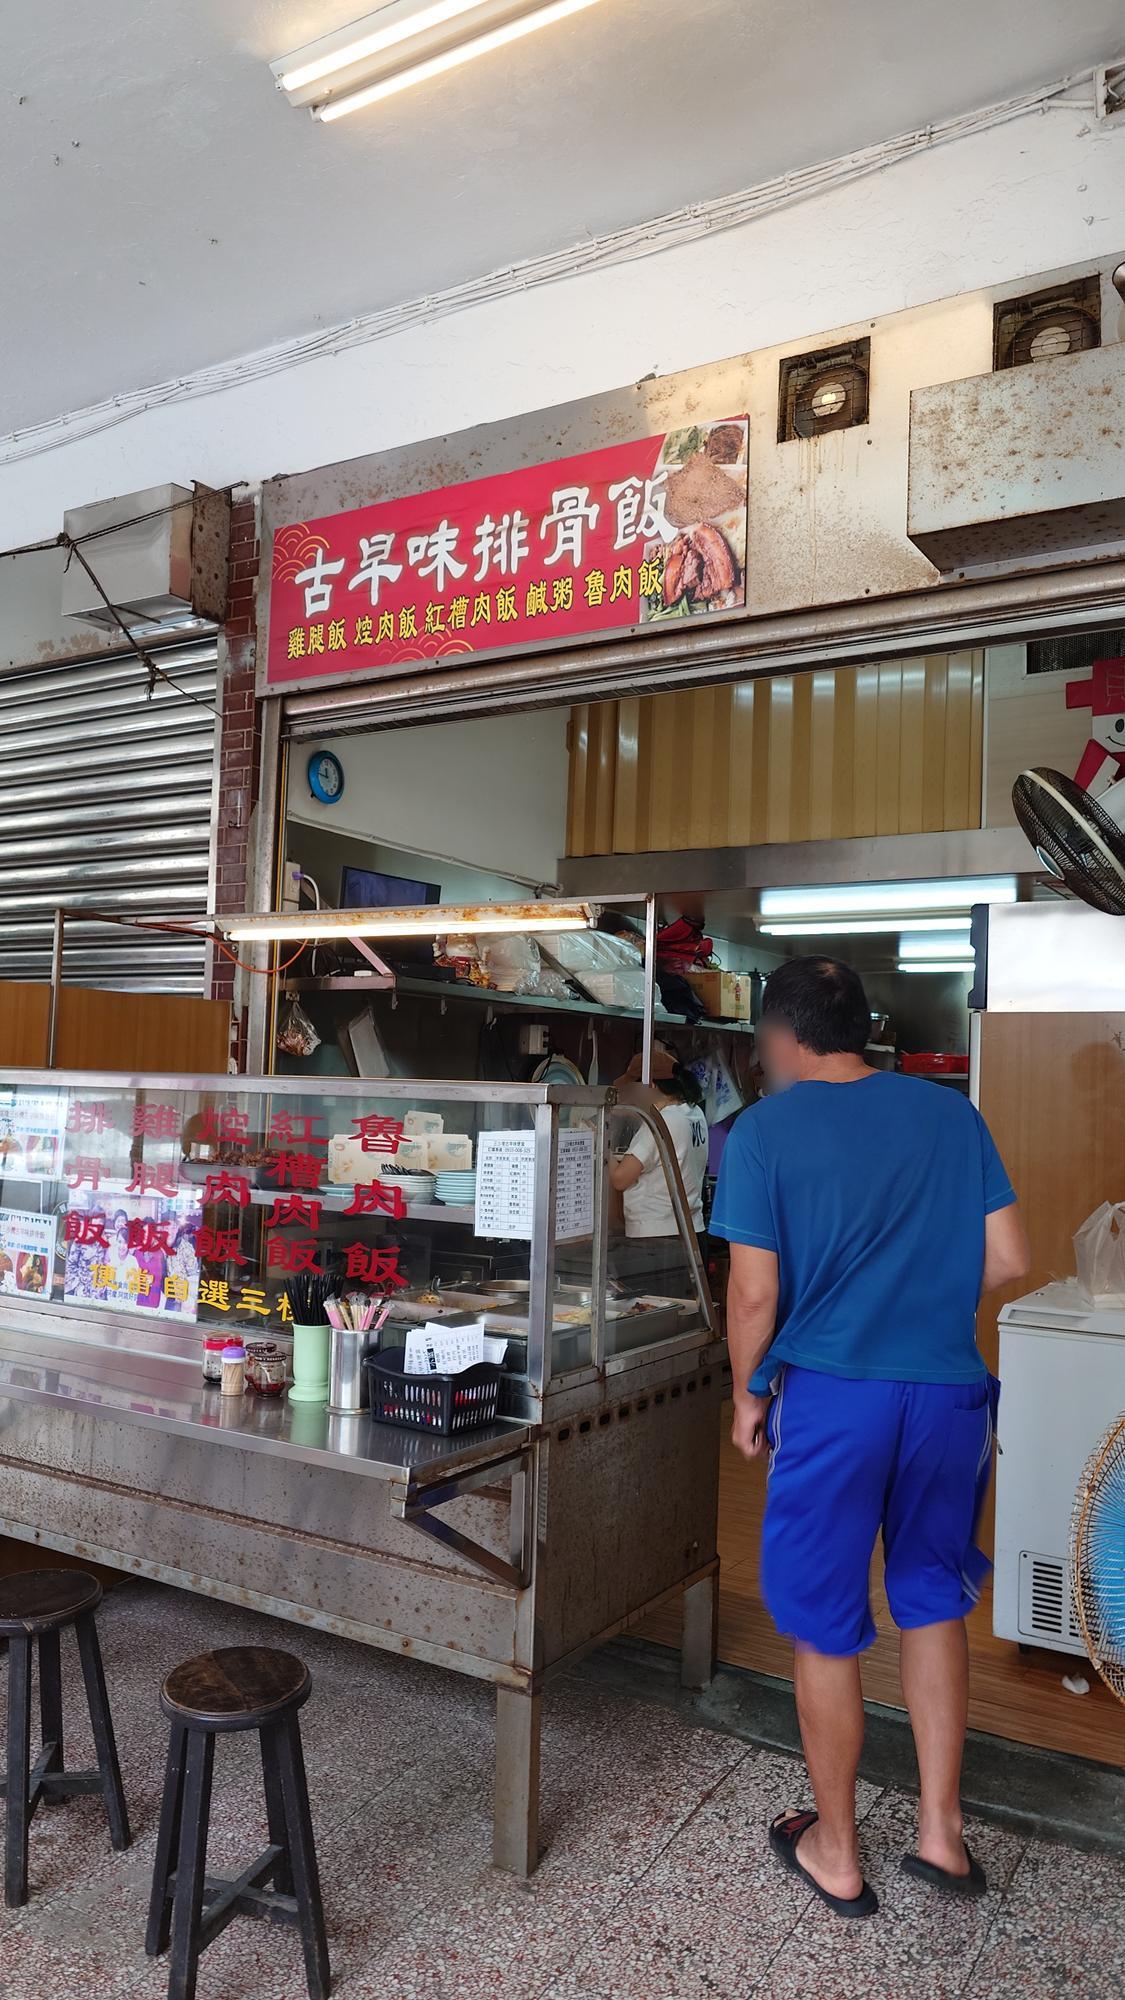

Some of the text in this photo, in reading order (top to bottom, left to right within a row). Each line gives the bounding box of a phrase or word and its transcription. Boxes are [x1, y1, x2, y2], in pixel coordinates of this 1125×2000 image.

[287, 618, 347, 660] 雞腿飯
[525, 577, 574, 618] 鹹粥
[583, 557, 663, 608] 魯肉飯
[294, 471, 680, 618] 古早味排骨飯
[62, 1100, 115, 1249] 排骨飯
[124, 1103, 182, 1256] 雞腿飯
[343, 1114, 412, 1288] 魯肉飯
